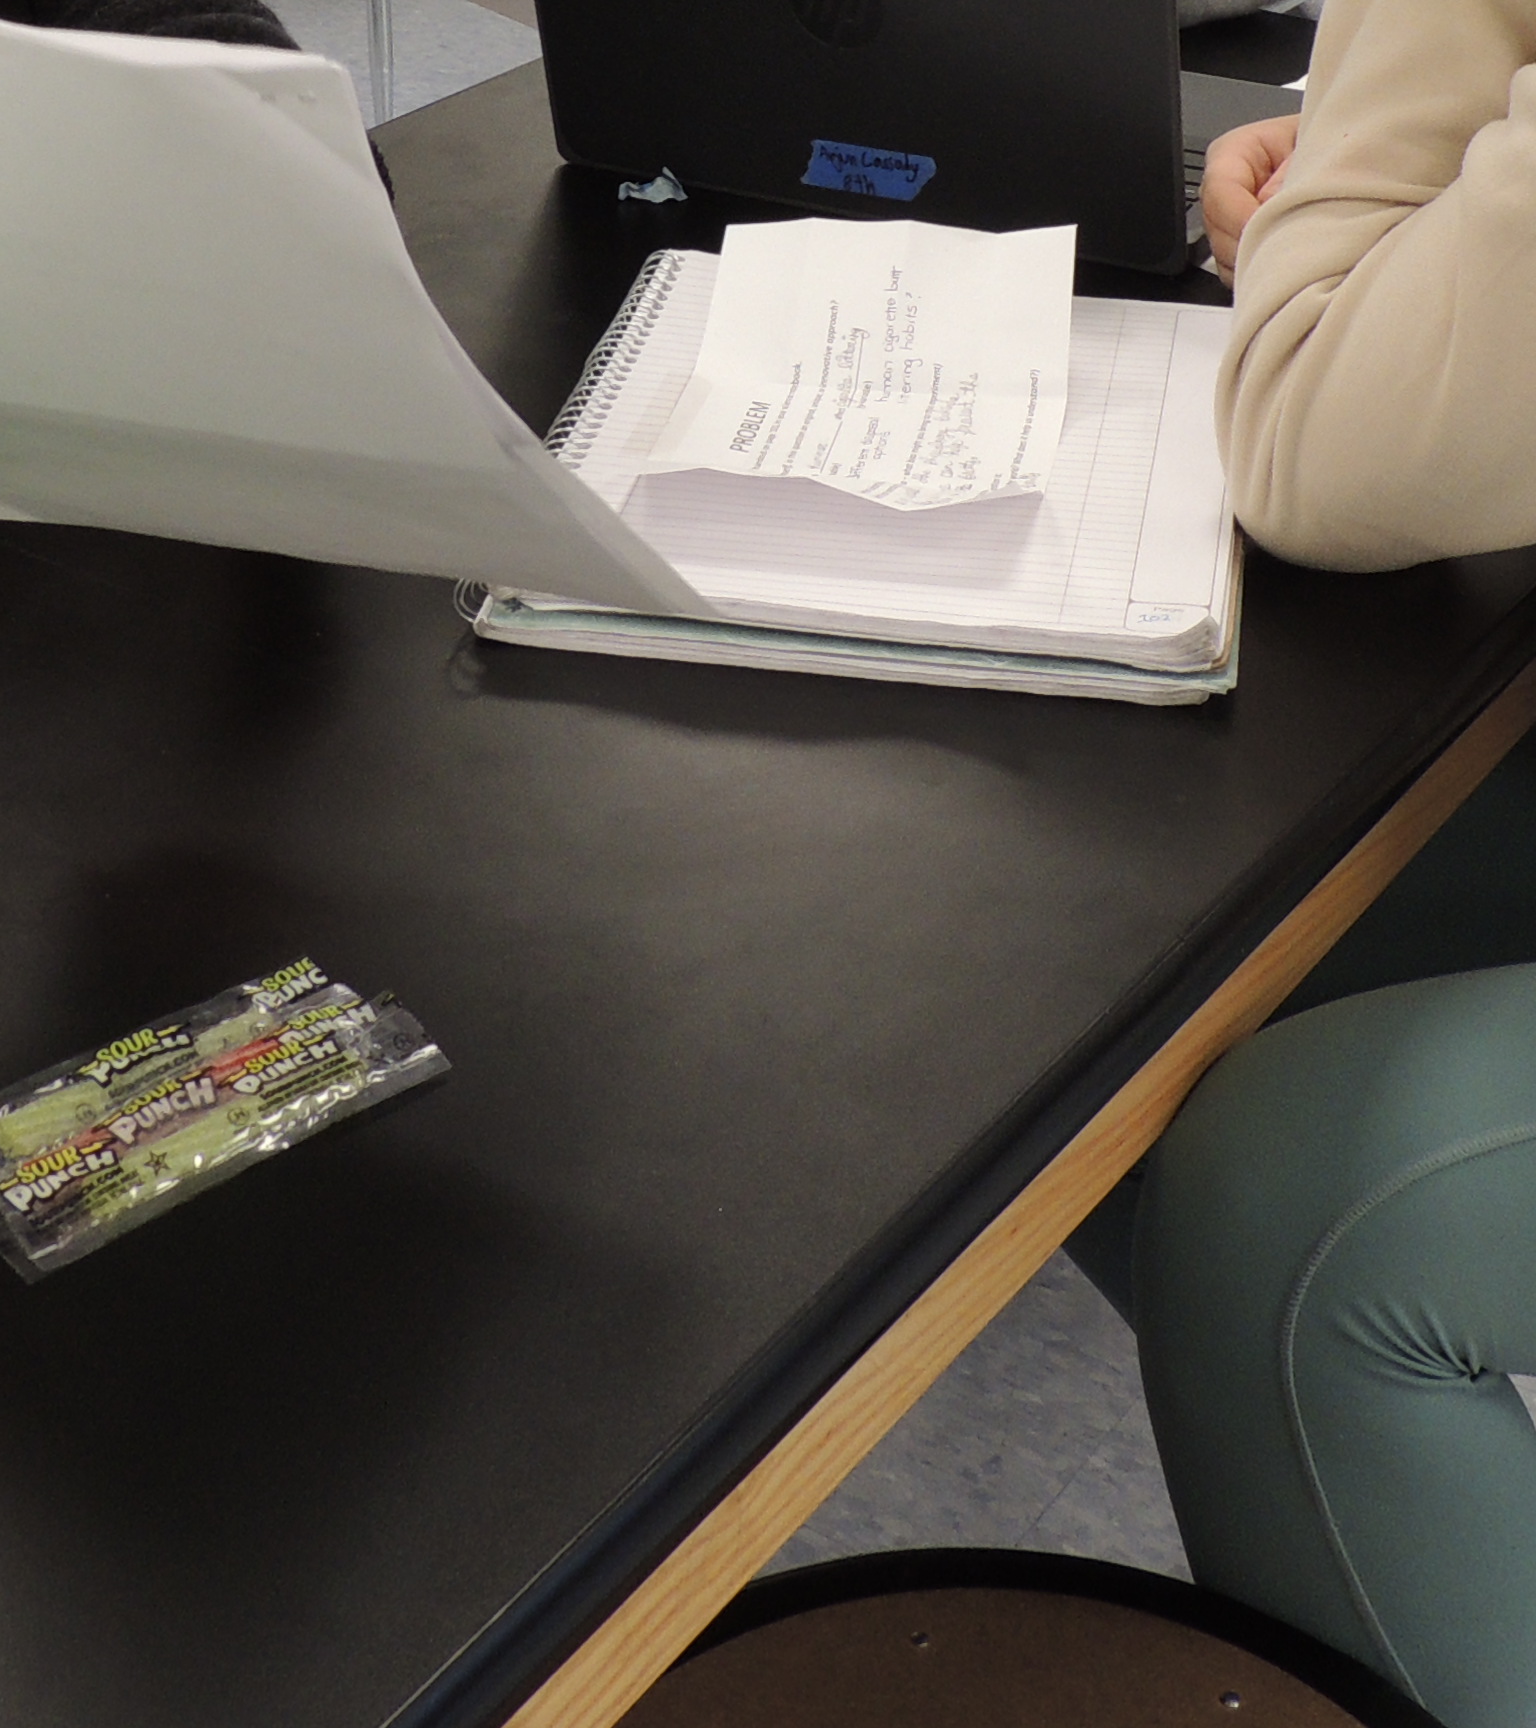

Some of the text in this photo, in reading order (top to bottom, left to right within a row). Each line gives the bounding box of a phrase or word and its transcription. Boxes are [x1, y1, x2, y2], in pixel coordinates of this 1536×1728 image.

[729, 401, 772, 454] PROBLEM
[287, 1002, 342, 1030] SOUR
[96, 1026, 160, 1064] SOUR
[244, 1036, 304, 1074] SOUR
[232, 1038, 338, 1095] PUNCH
[108, 1075, 217, 1145] PUNCH
[120, 1075, 182, 1115] SOUR
[2, 1149, 117, 1214] PUNCH
[14, 1144, 81, 1186] SOUR
